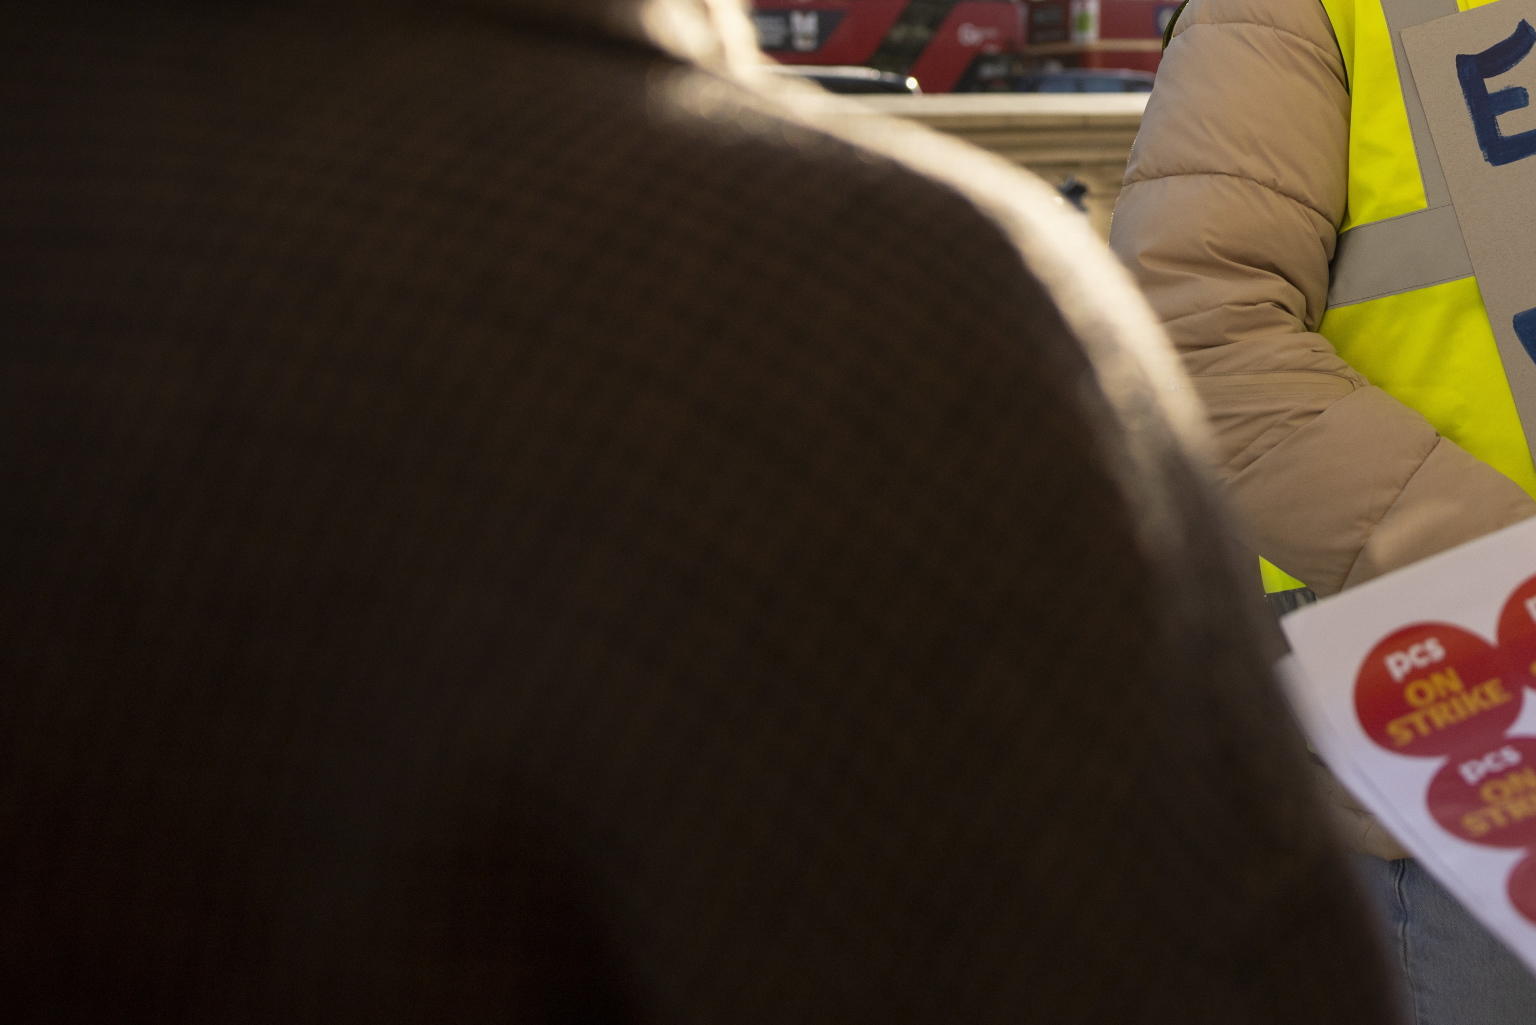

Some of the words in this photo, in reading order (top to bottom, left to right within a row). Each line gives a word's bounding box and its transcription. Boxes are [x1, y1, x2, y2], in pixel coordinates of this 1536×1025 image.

[1386, 638, 1444, 680] pcs
[1406, 668, 1462, 705] ON
[1388, 680, 1510, 745] STRIKE
